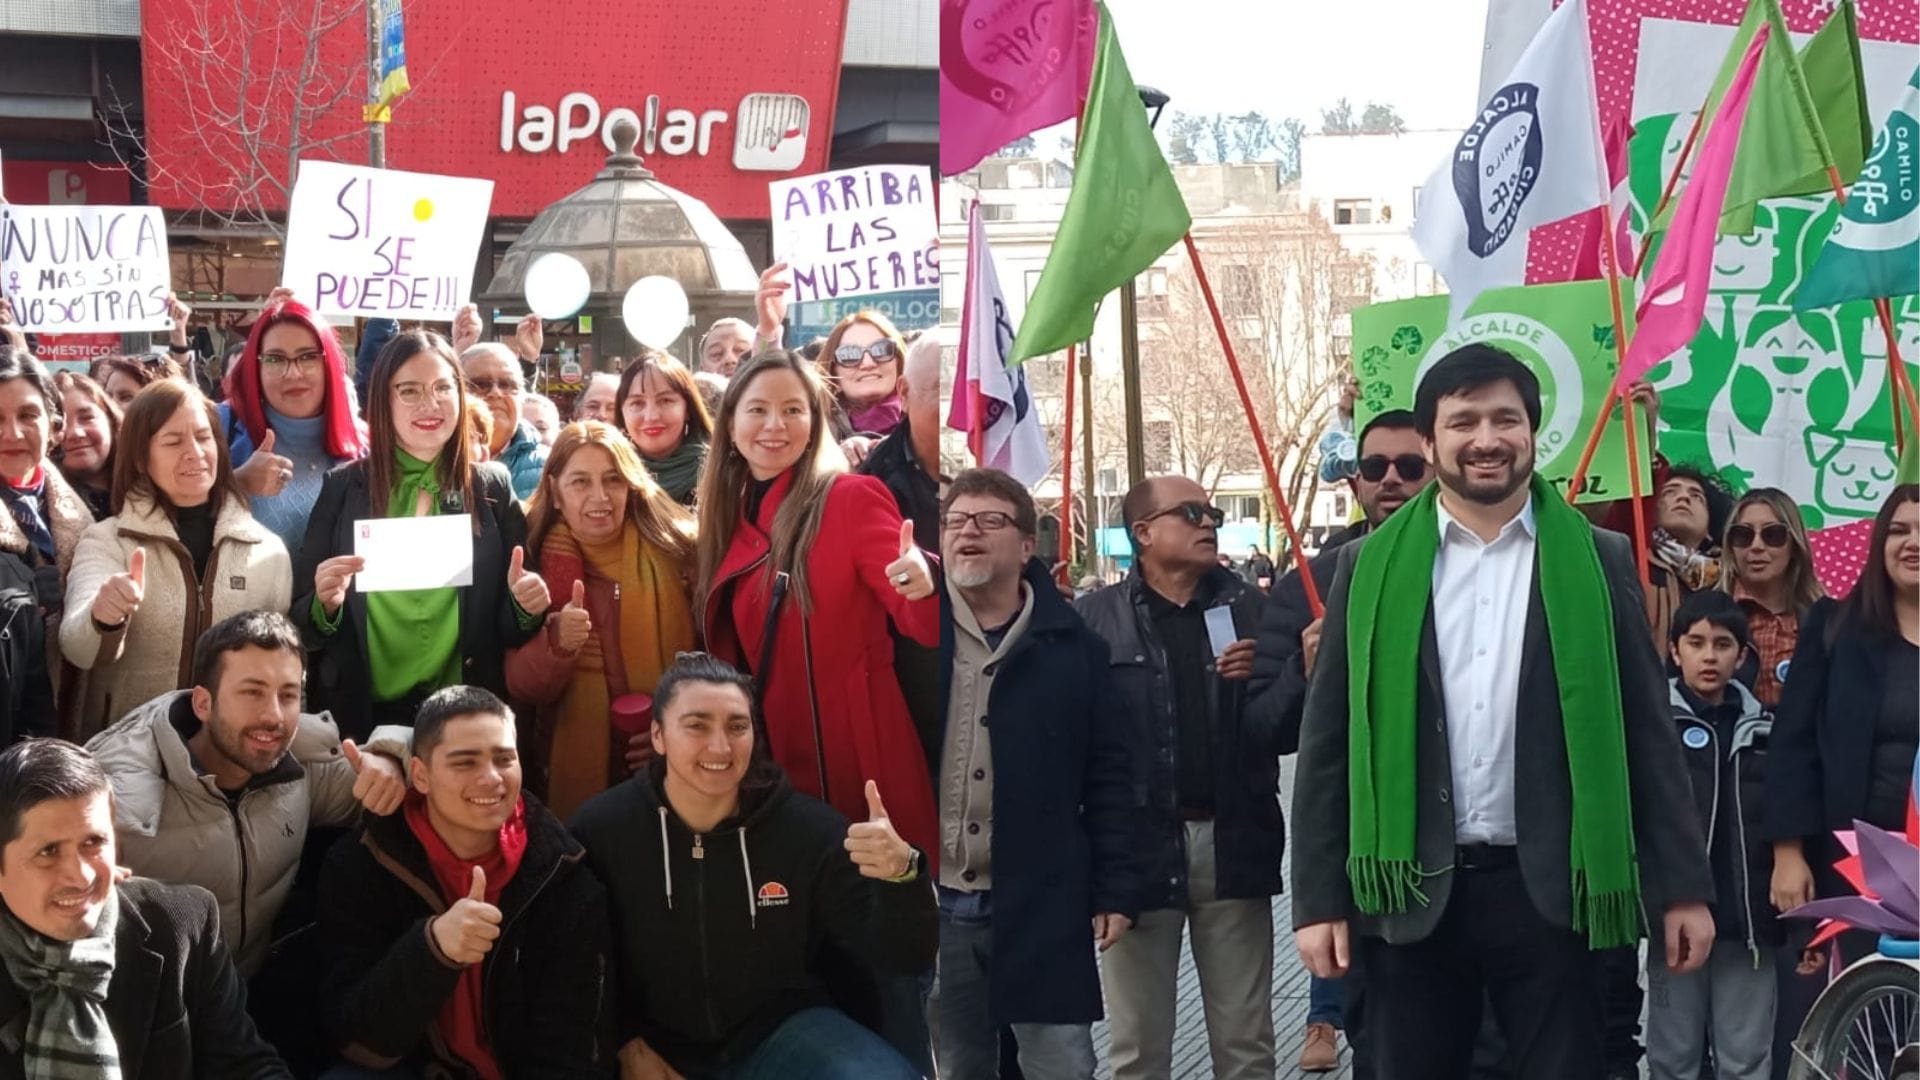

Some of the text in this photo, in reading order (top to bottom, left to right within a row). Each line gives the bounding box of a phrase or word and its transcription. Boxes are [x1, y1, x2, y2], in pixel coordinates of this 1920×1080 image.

[501, 90, 728, 156] laPolar
[1895, 127, 1913, 201] CAMILO
[328, 176, 372, 241] SI
[784, 170, 923, 222] ARRIBA
[372, 236, 416, 277] SE
[826, 216, 897, 253] LAS
[37, 268, 86, 292] MAS
[316, 272, 458, 312] PUEDE!!!
[793, 245, 940, 302] MUJERES
[1444, 318, 1545, 351] ALCALDE
